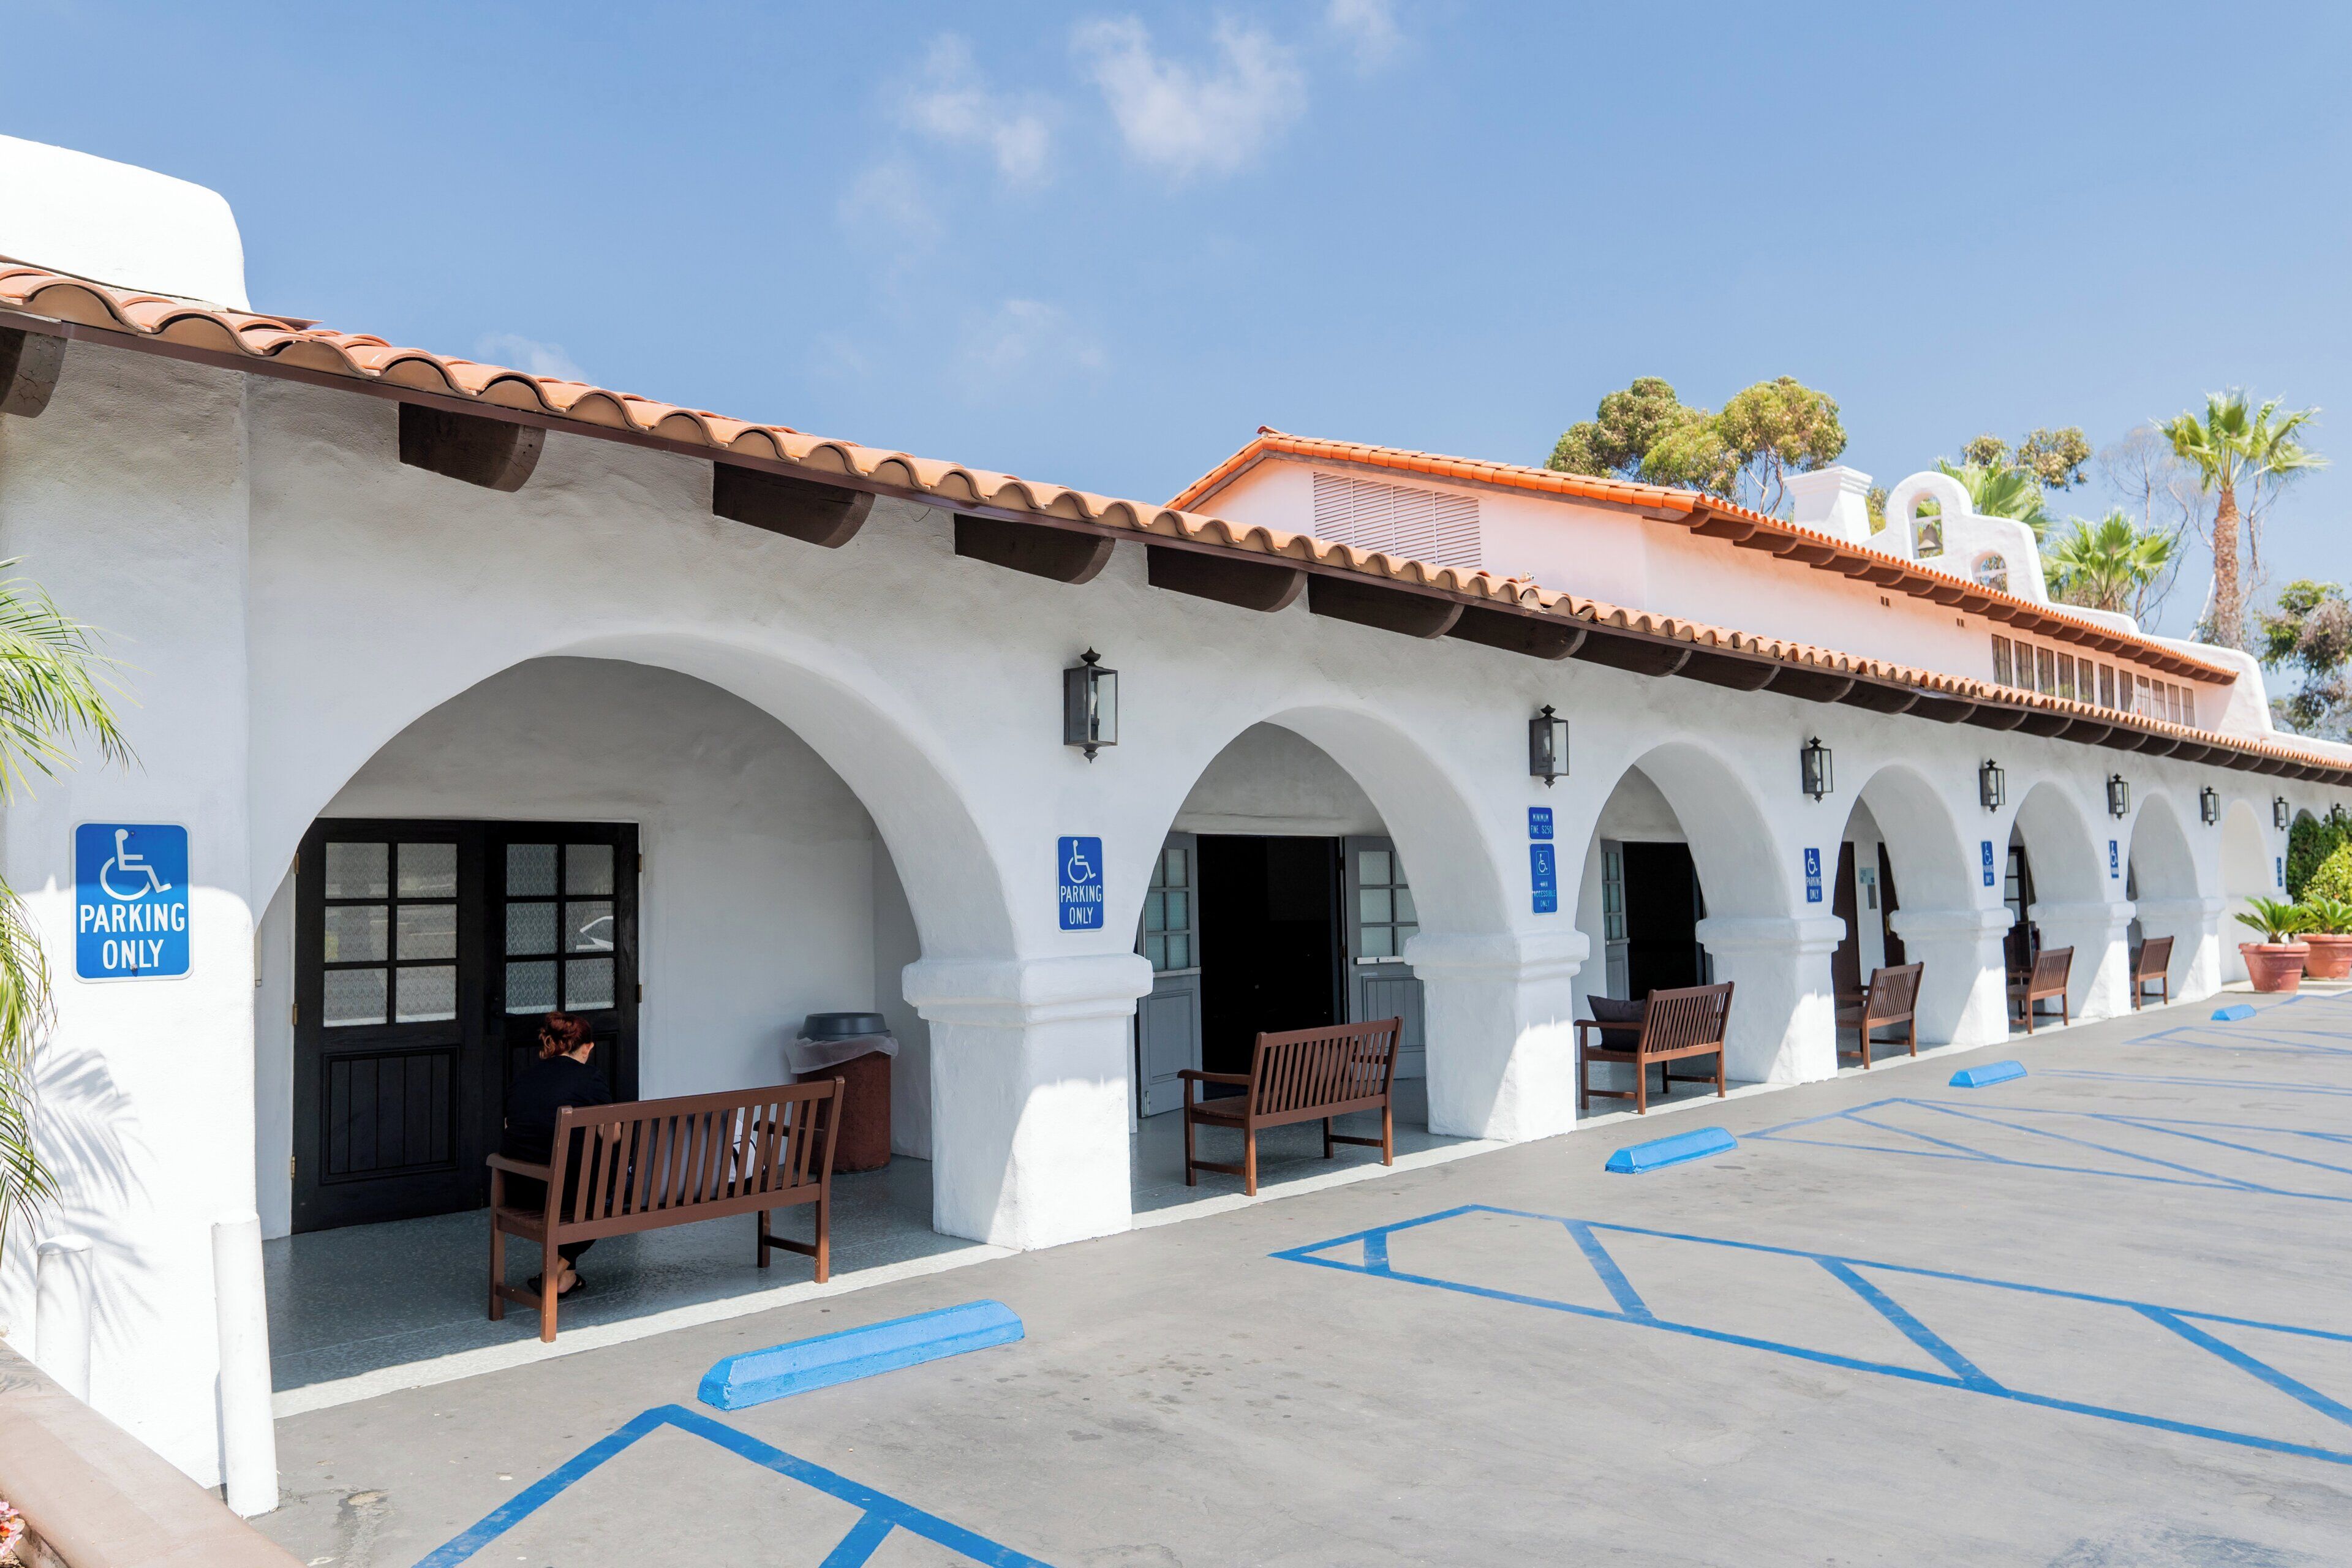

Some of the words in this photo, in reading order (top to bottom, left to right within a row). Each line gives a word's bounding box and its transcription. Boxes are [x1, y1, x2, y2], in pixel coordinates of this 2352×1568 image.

[1532, 813, 1549, 822] MINIMUM
[1542, 825, 1552, 834] $250
[1806, 876, 1822, 886] PARKING
[1060, 885, 1102, 903] PARKING
[1809, 889, 1819, 899] ONLY
[80, 903, 185, 933] PARKING
[1069, 907, 1093, 925] ONLY
[102, 939, 164, 970] ONLY
